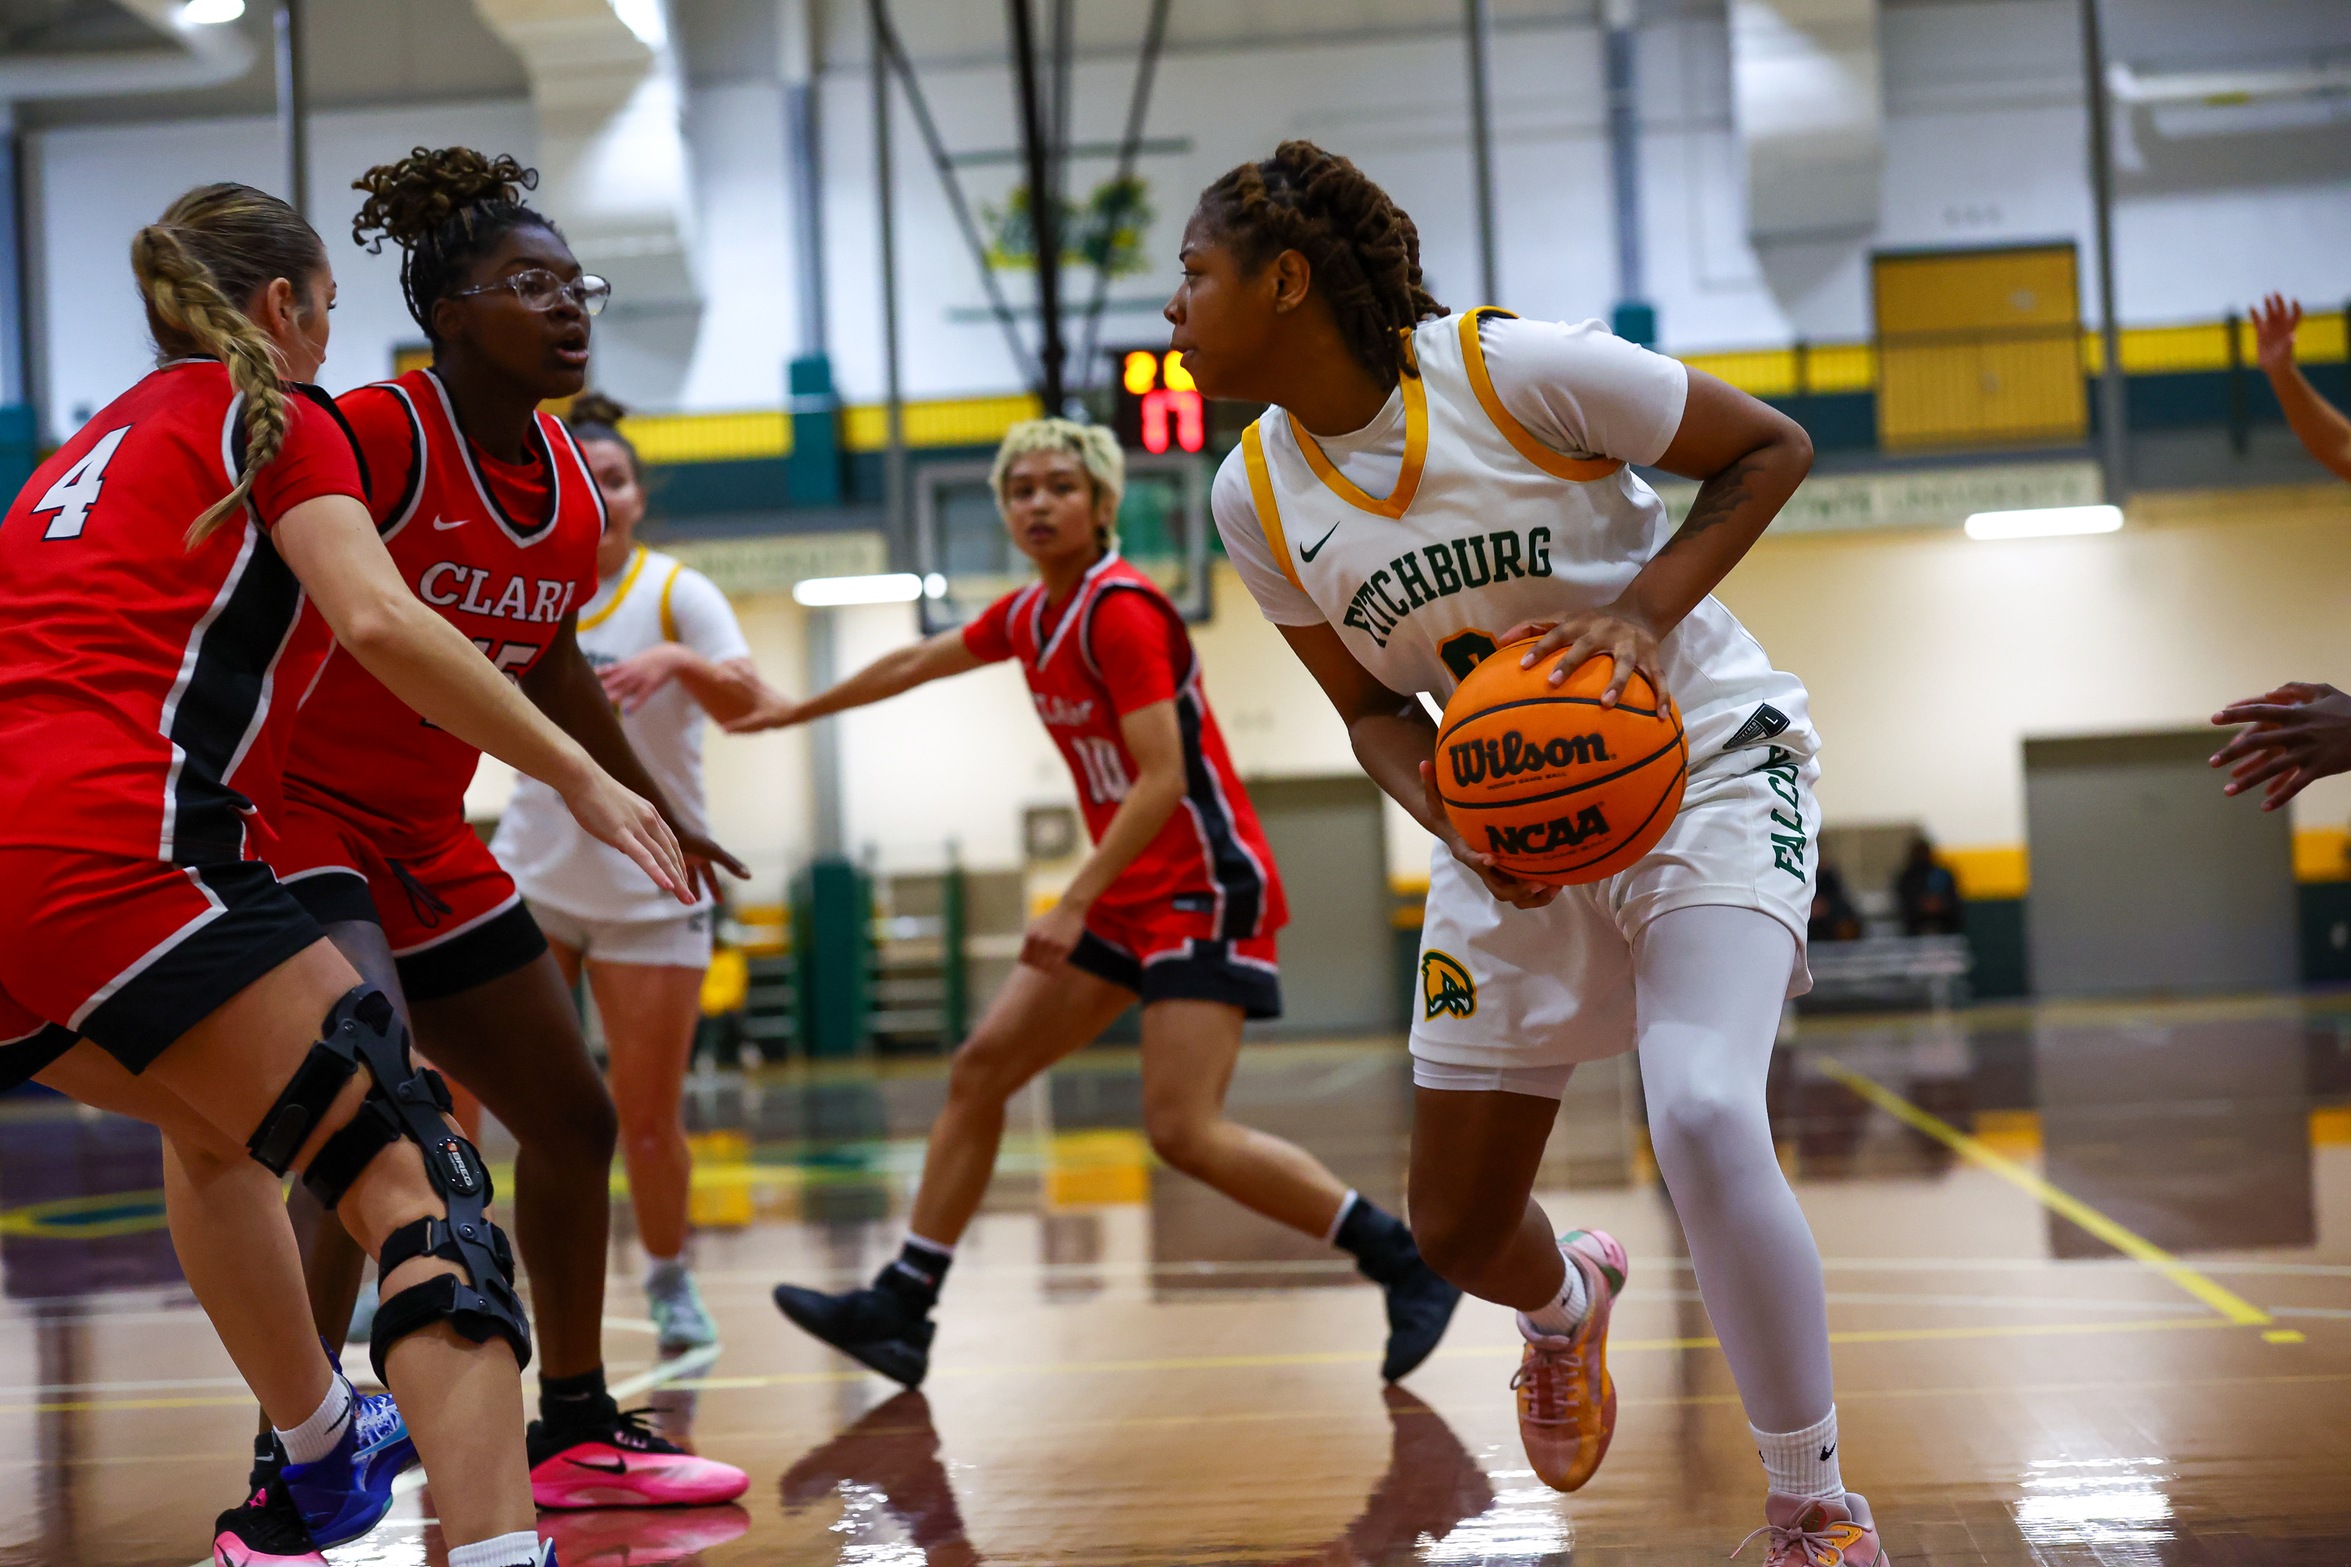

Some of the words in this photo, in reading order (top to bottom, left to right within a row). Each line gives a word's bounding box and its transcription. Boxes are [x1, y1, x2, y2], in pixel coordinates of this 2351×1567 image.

[29, 422, 135, 542] 4
[1343, 526, 1553, 649] FITCHBURG
[1764, 715, 1779, 725] L
[1449, 730, 1611, 788] Wilson
[1485, 804, 1611, 855] NCAA
